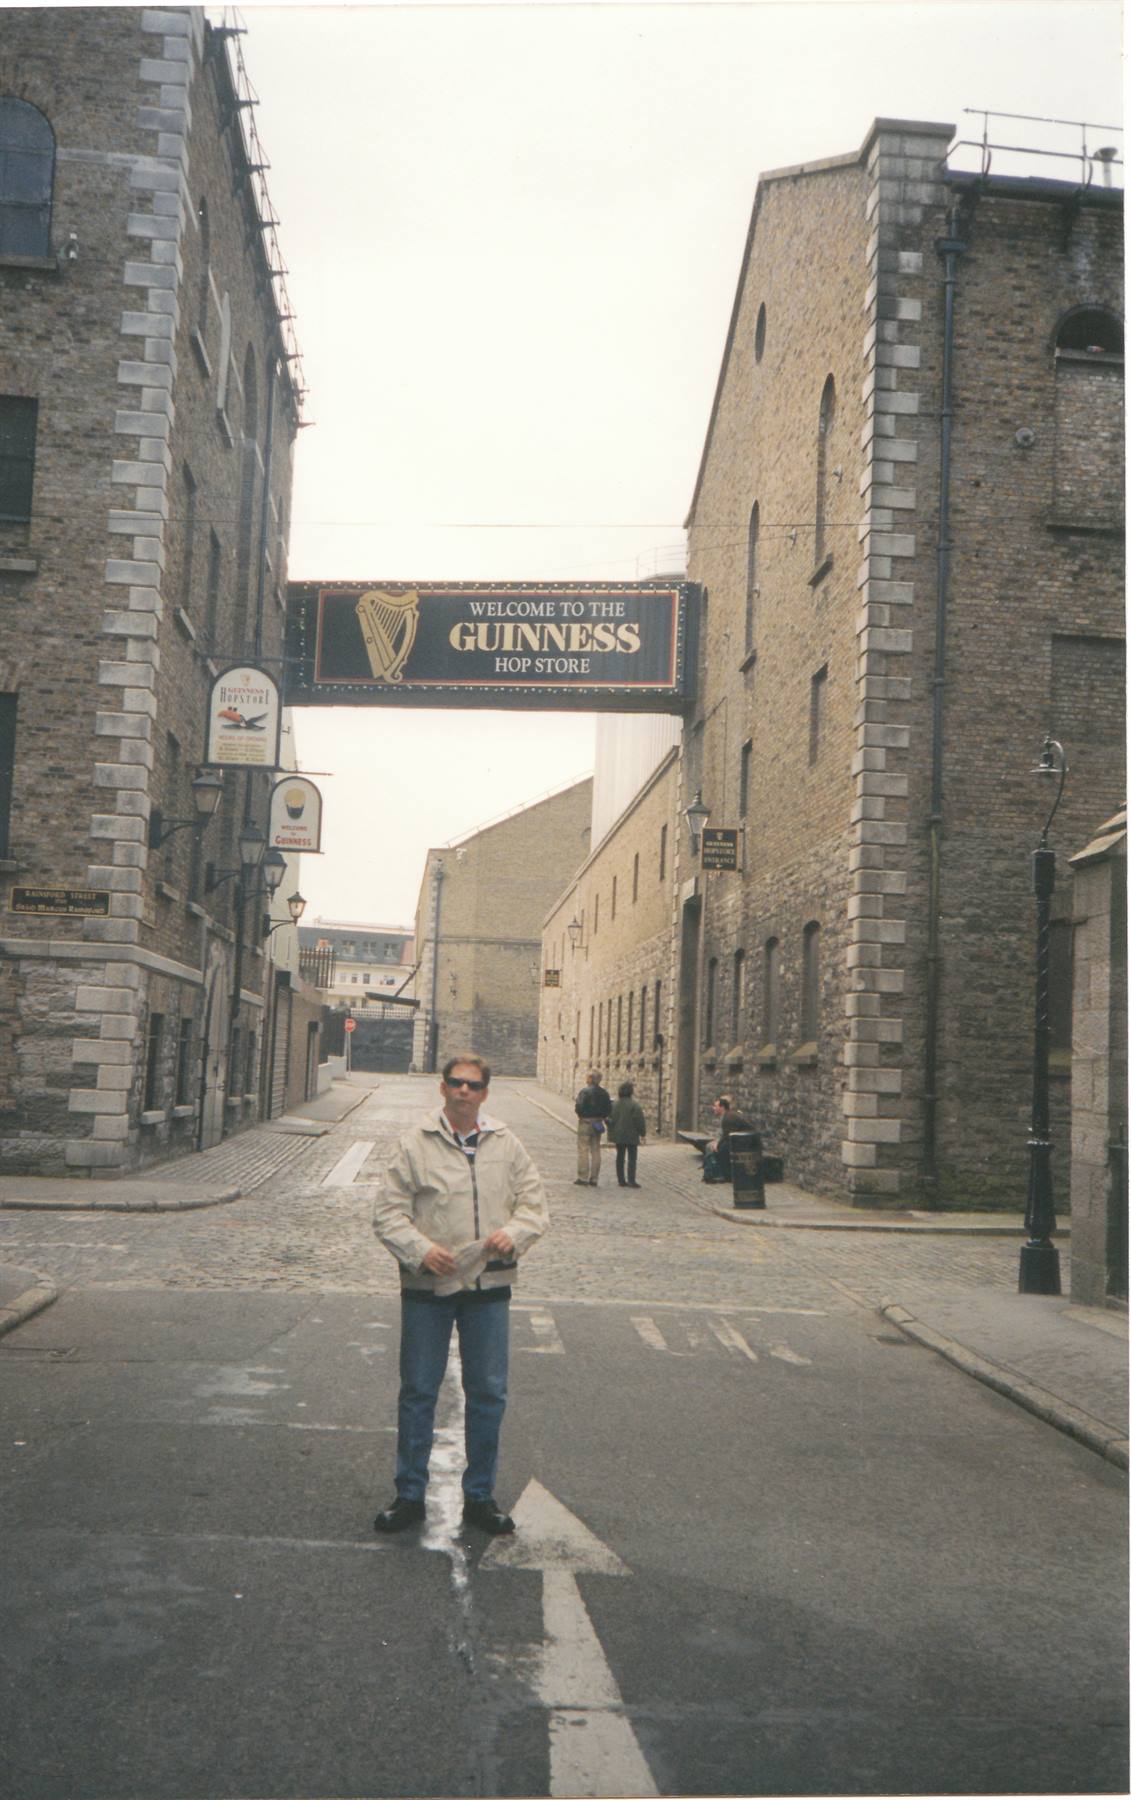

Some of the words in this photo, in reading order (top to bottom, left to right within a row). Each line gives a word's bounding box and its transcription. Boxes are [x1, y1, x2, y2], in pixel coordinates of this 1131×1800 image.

[469, 602, 555, 617] WELCOME
[559, 602, 584, 617] TO
[588, 602, 625, 617] THE
[448, 622, 641, 654] GUINNESS
[495, 657, 531, 673] HOP
[535, 657, 591, 673] STORE
[219, 686, 270, 705] HOPSTORE
[274, 835, 312, 846] GUINNESS
[70, 892, 96, 900] STREET
